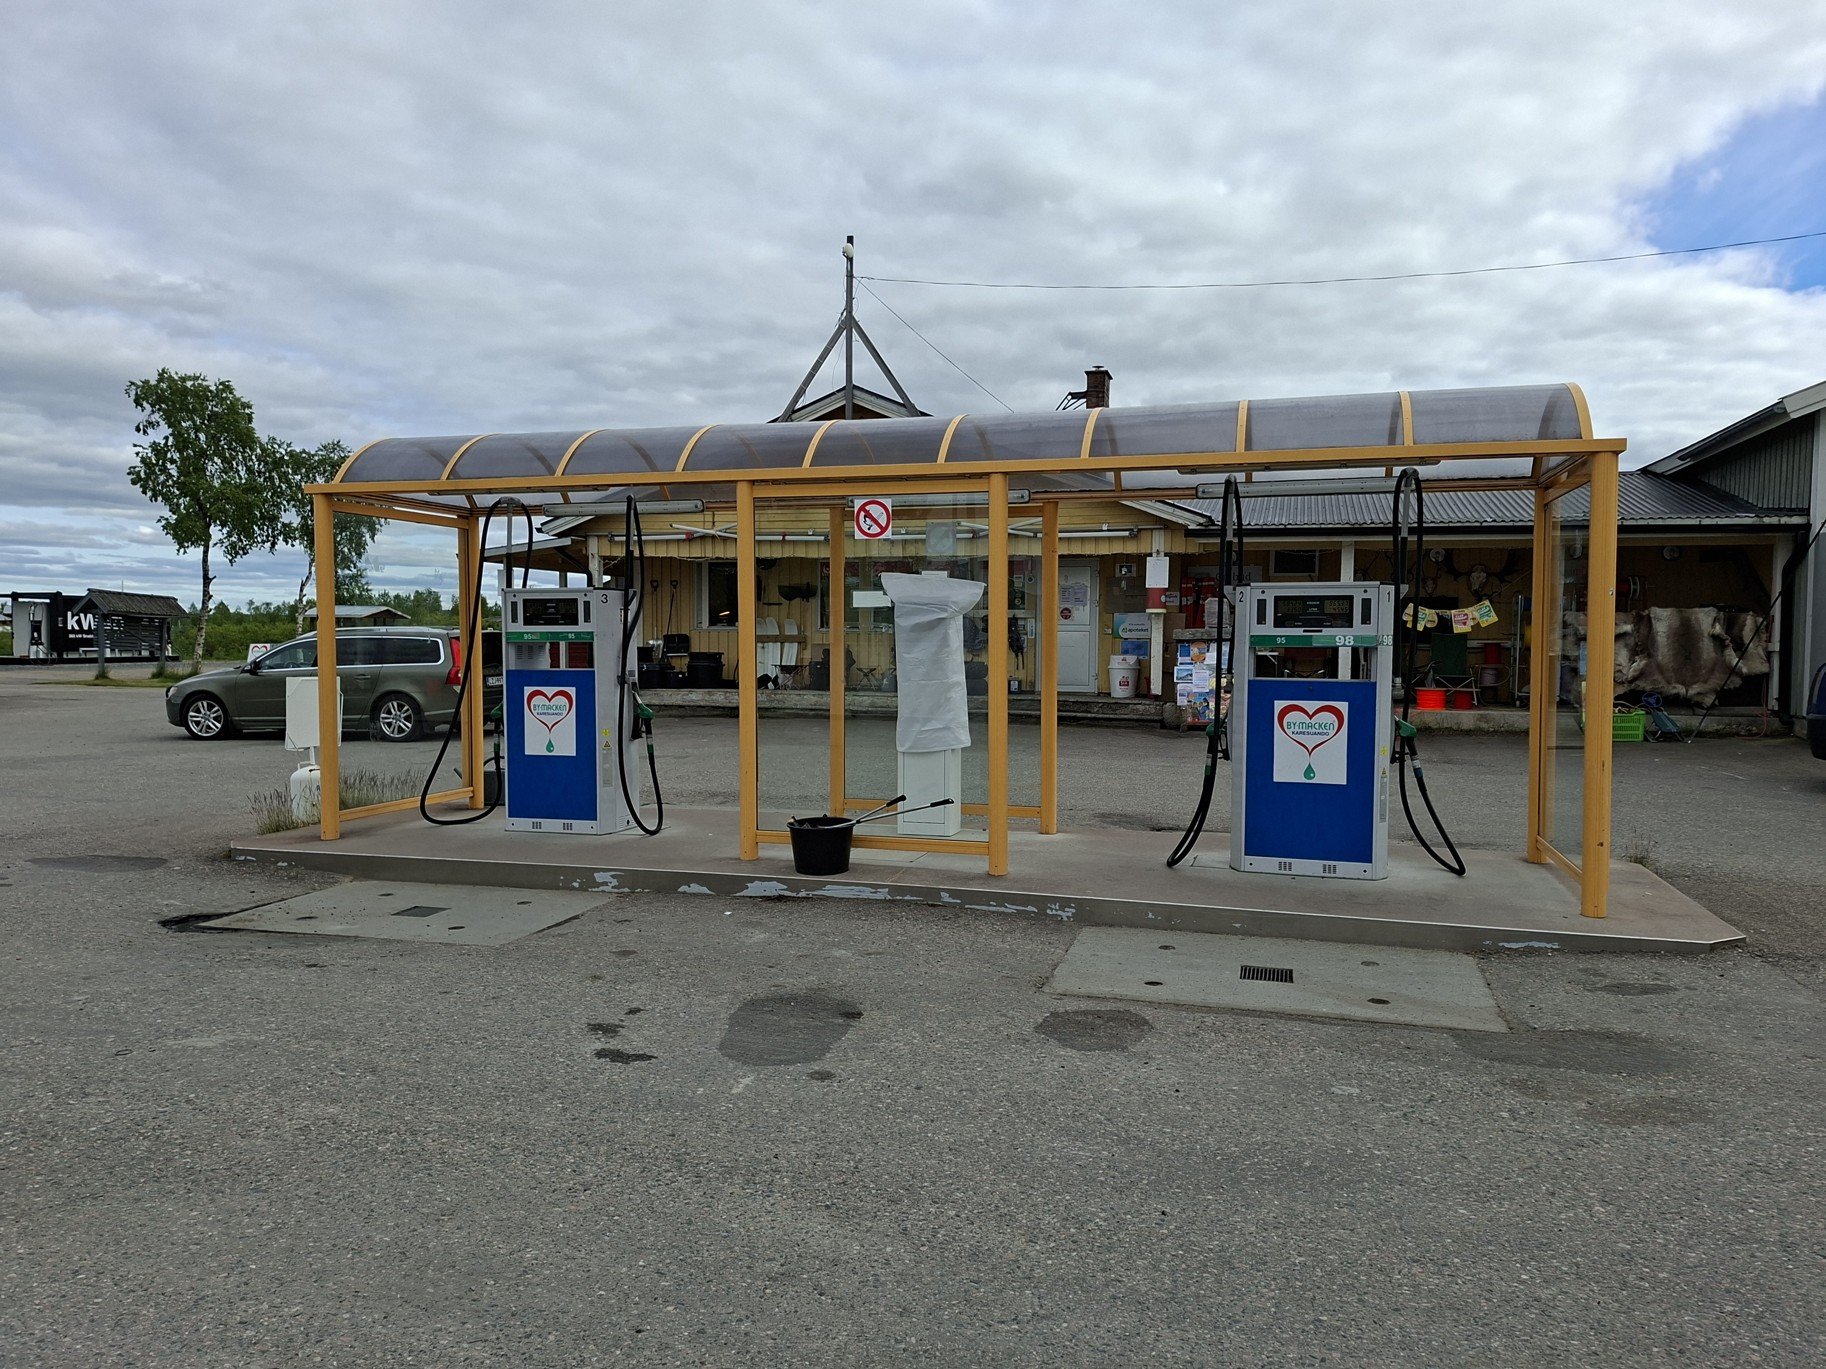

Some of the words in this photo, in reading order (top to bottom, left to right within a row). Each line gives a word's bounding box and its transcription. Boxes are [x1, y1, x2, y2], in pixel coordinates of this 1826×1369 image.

[600, 593, 608, 604] 3
[1238, 591, 1244, 602] 2
[1386, 591, 1391, 602] 1
[1335, 635, 1354, 646] 98
[1382, 634, 1393, 646] 98
